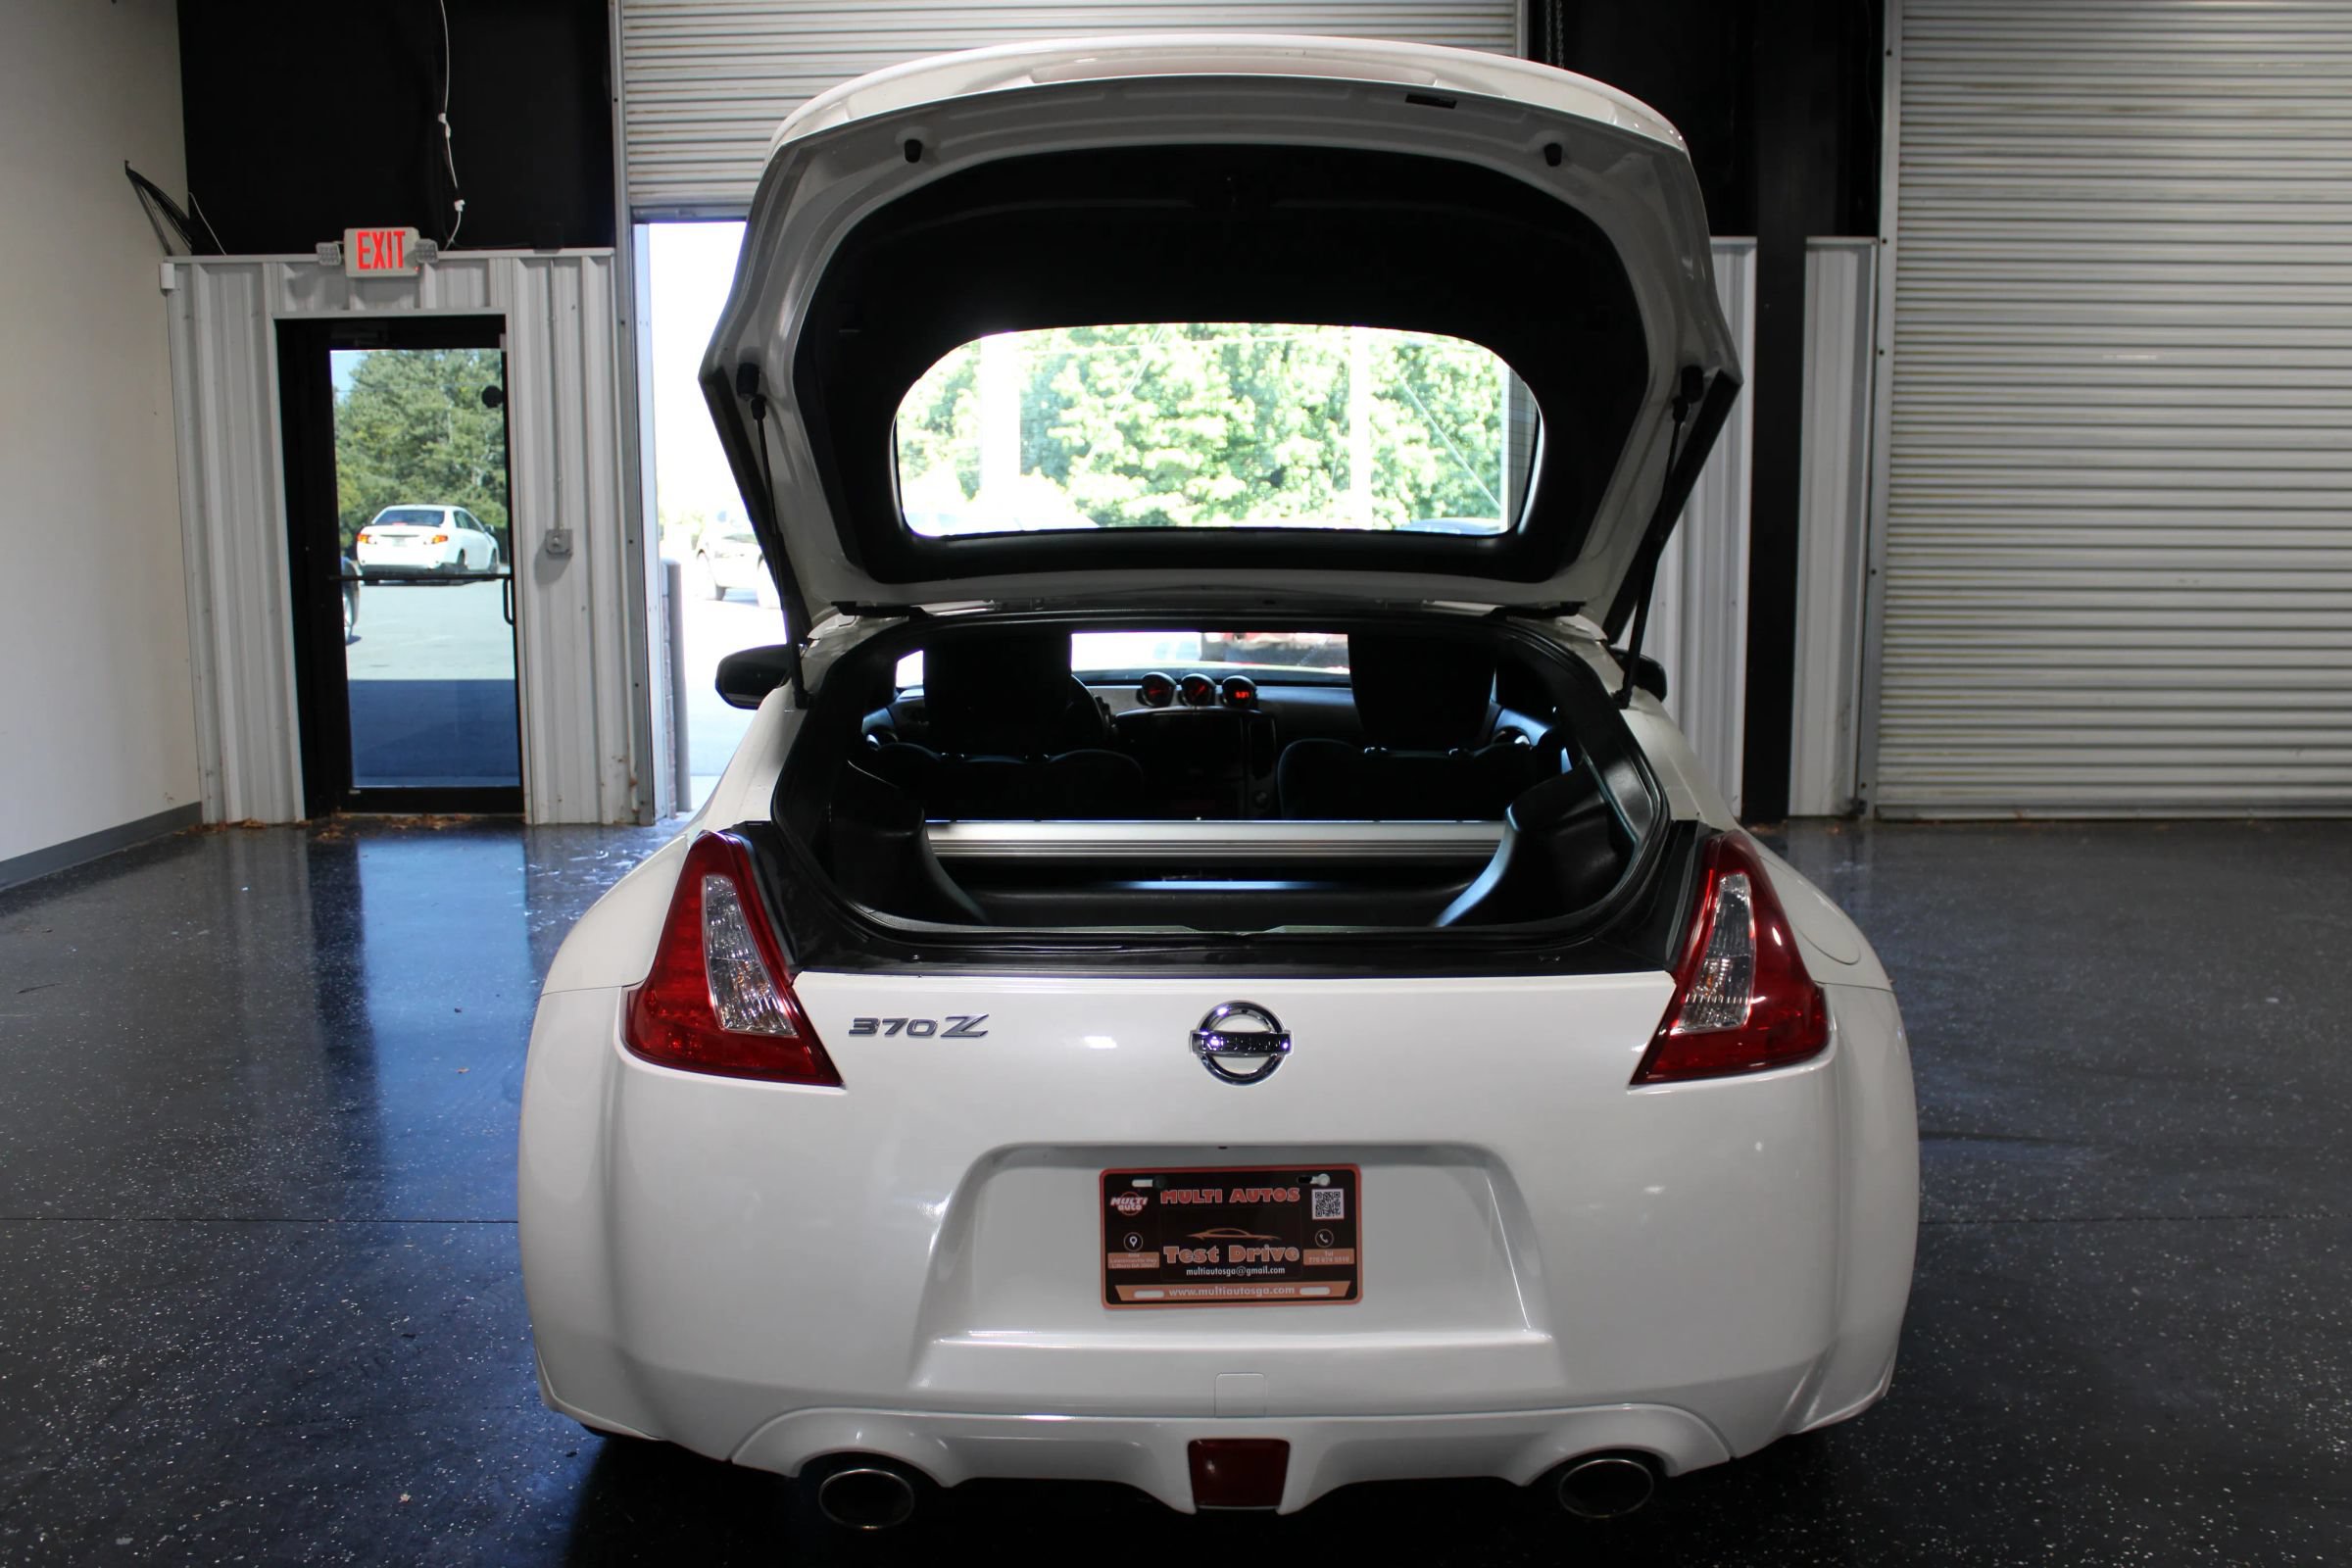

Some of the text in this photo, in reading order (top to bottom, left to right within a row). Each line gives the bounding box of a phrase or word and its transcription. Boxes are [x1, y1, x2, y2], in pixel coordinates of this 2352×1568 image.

[357, 230, 406, 270] EXIT
[849, 1014, 990, 1038] 370Z
[1110, 1197, 1149, 1205] MULTI
[1160, 1187, 1300, 1204] MULTI AUTOS
[1163, 1244, 1299, 1264] Test Drive
[1186, 1265, 1286, 1277] multiautosga@gmail.com
[1169, 1285, 1296, 1297] www.multiautosga.com
